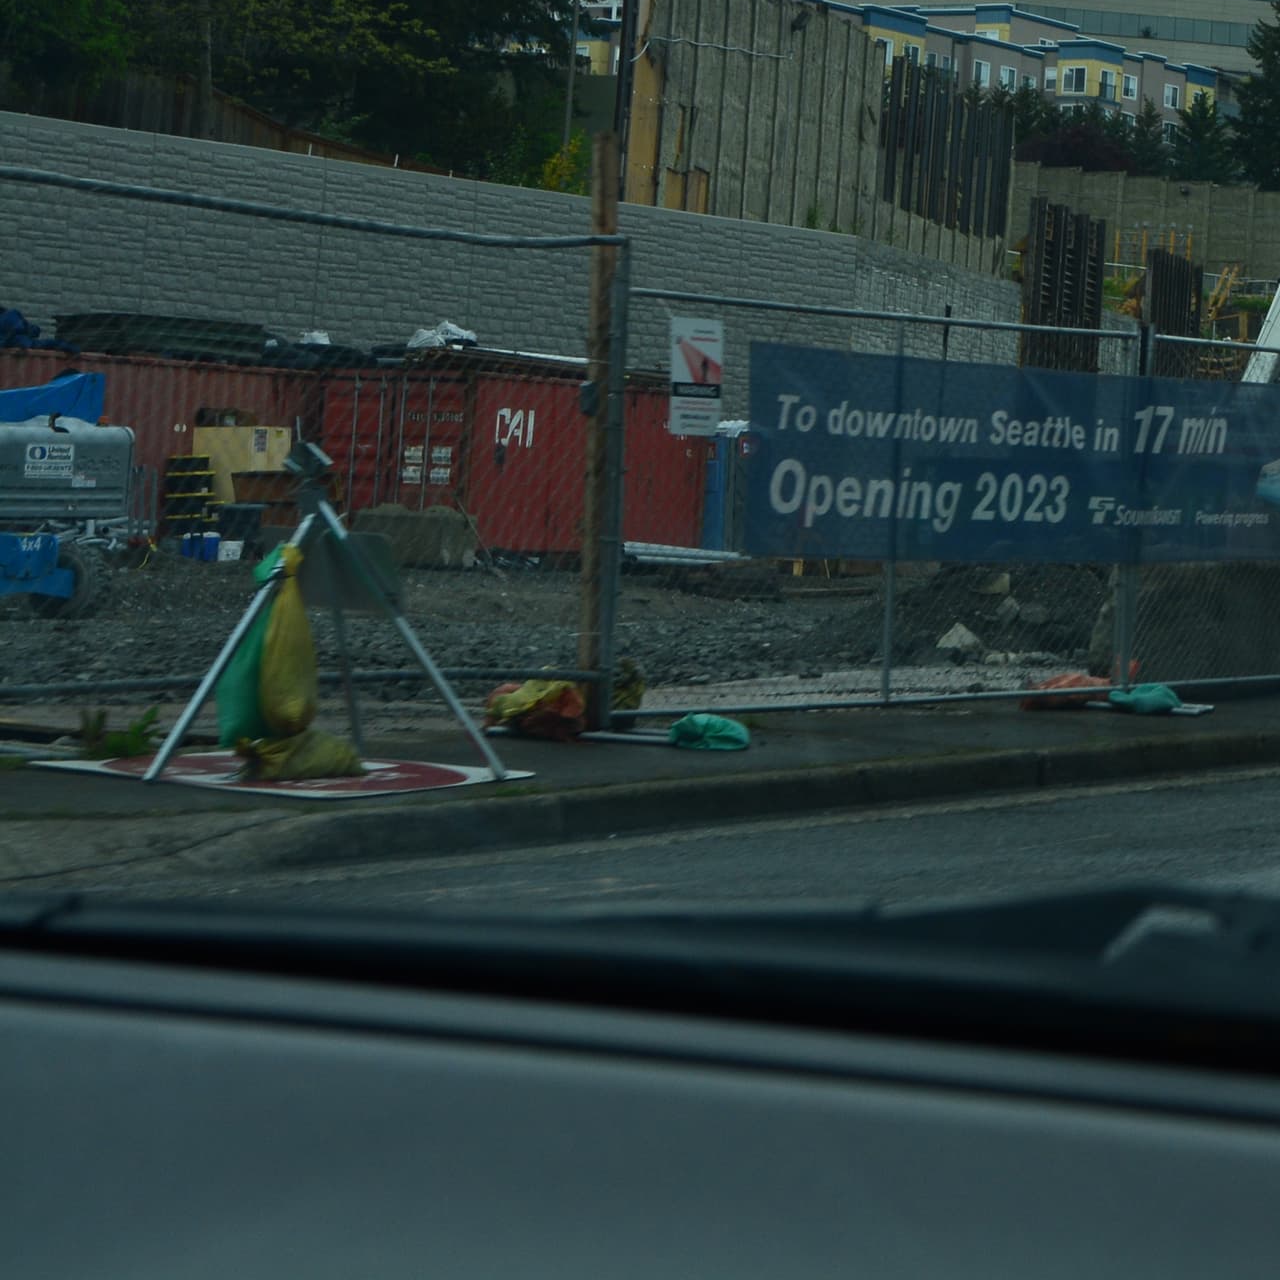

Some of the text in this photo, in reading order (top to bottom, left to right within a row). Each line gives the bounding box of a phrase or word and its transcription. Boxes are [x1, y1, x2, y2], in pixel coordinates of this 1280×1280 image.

[776, 394, 1228, 455] To downtown Seattle in 17 min
[769, 458, 1071, 534] Opening 2023
[20, 536, 42, 552] 4x4
